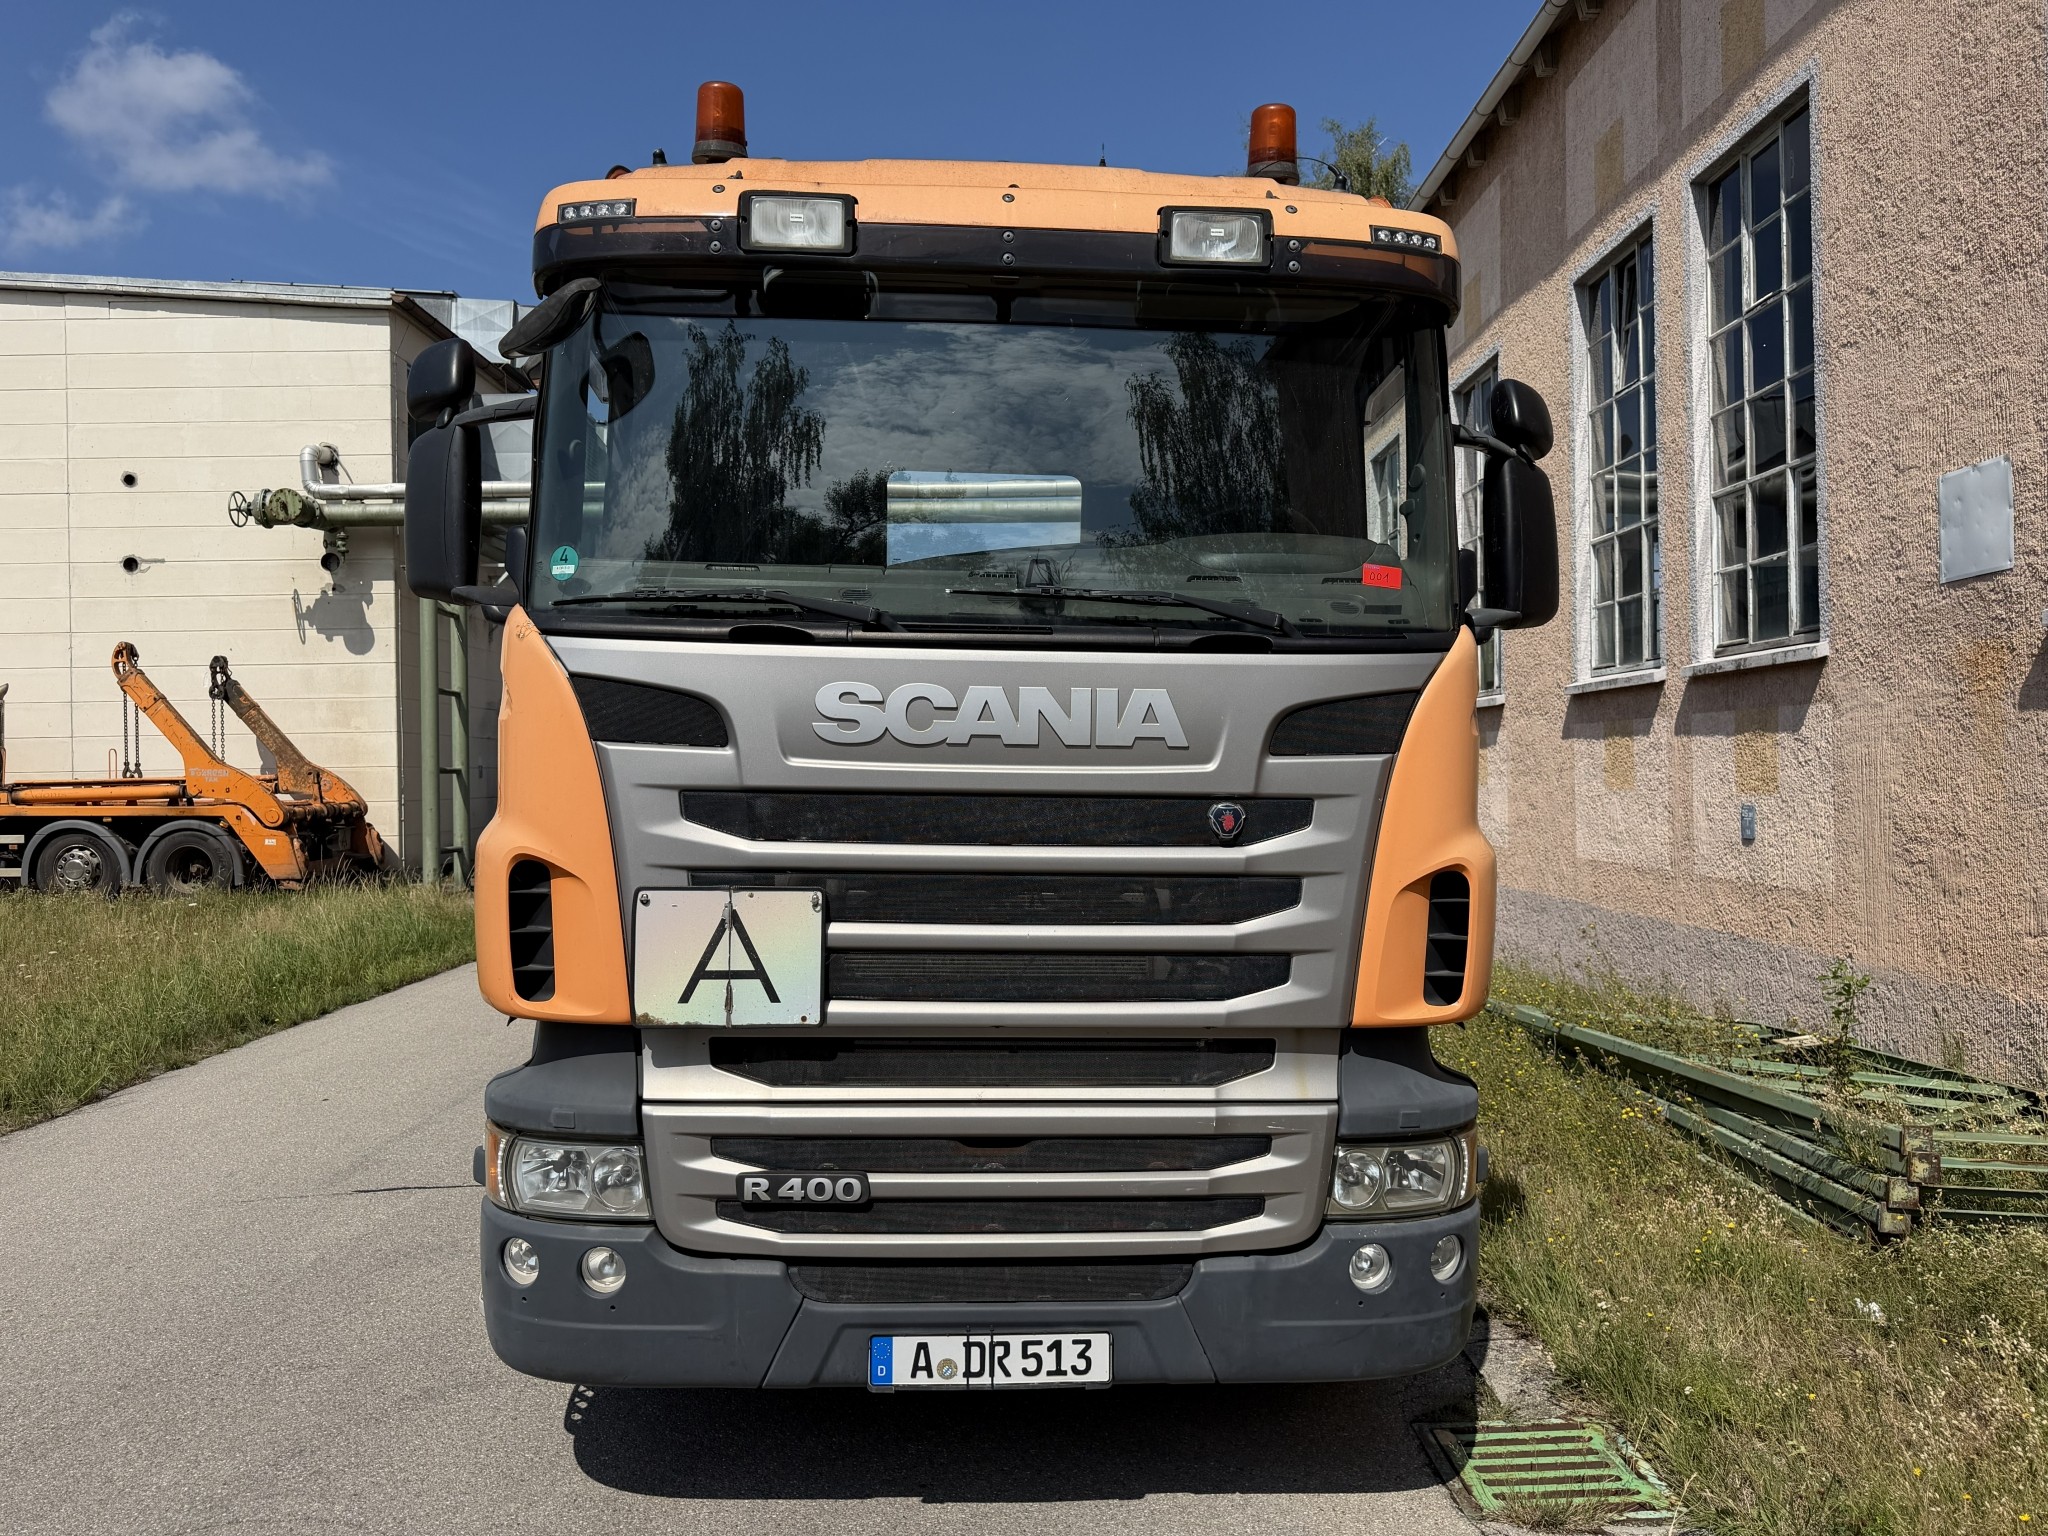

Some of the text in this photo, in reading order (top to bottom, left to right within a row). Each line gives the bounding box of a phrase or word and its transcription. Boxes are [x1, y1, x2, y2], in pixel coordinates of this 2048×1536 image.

[560, 548, 568, 563] 4
[1369, 572, 1390, 583] 001
[811, 680, 1190, 750] SCANIA
[677, 906, 782, 1004] A
[743, 1177, 862, 1202] R 400
[877, 1365, 886, 1377] D
[910, 1338, 1092, 1379] A DR 513
